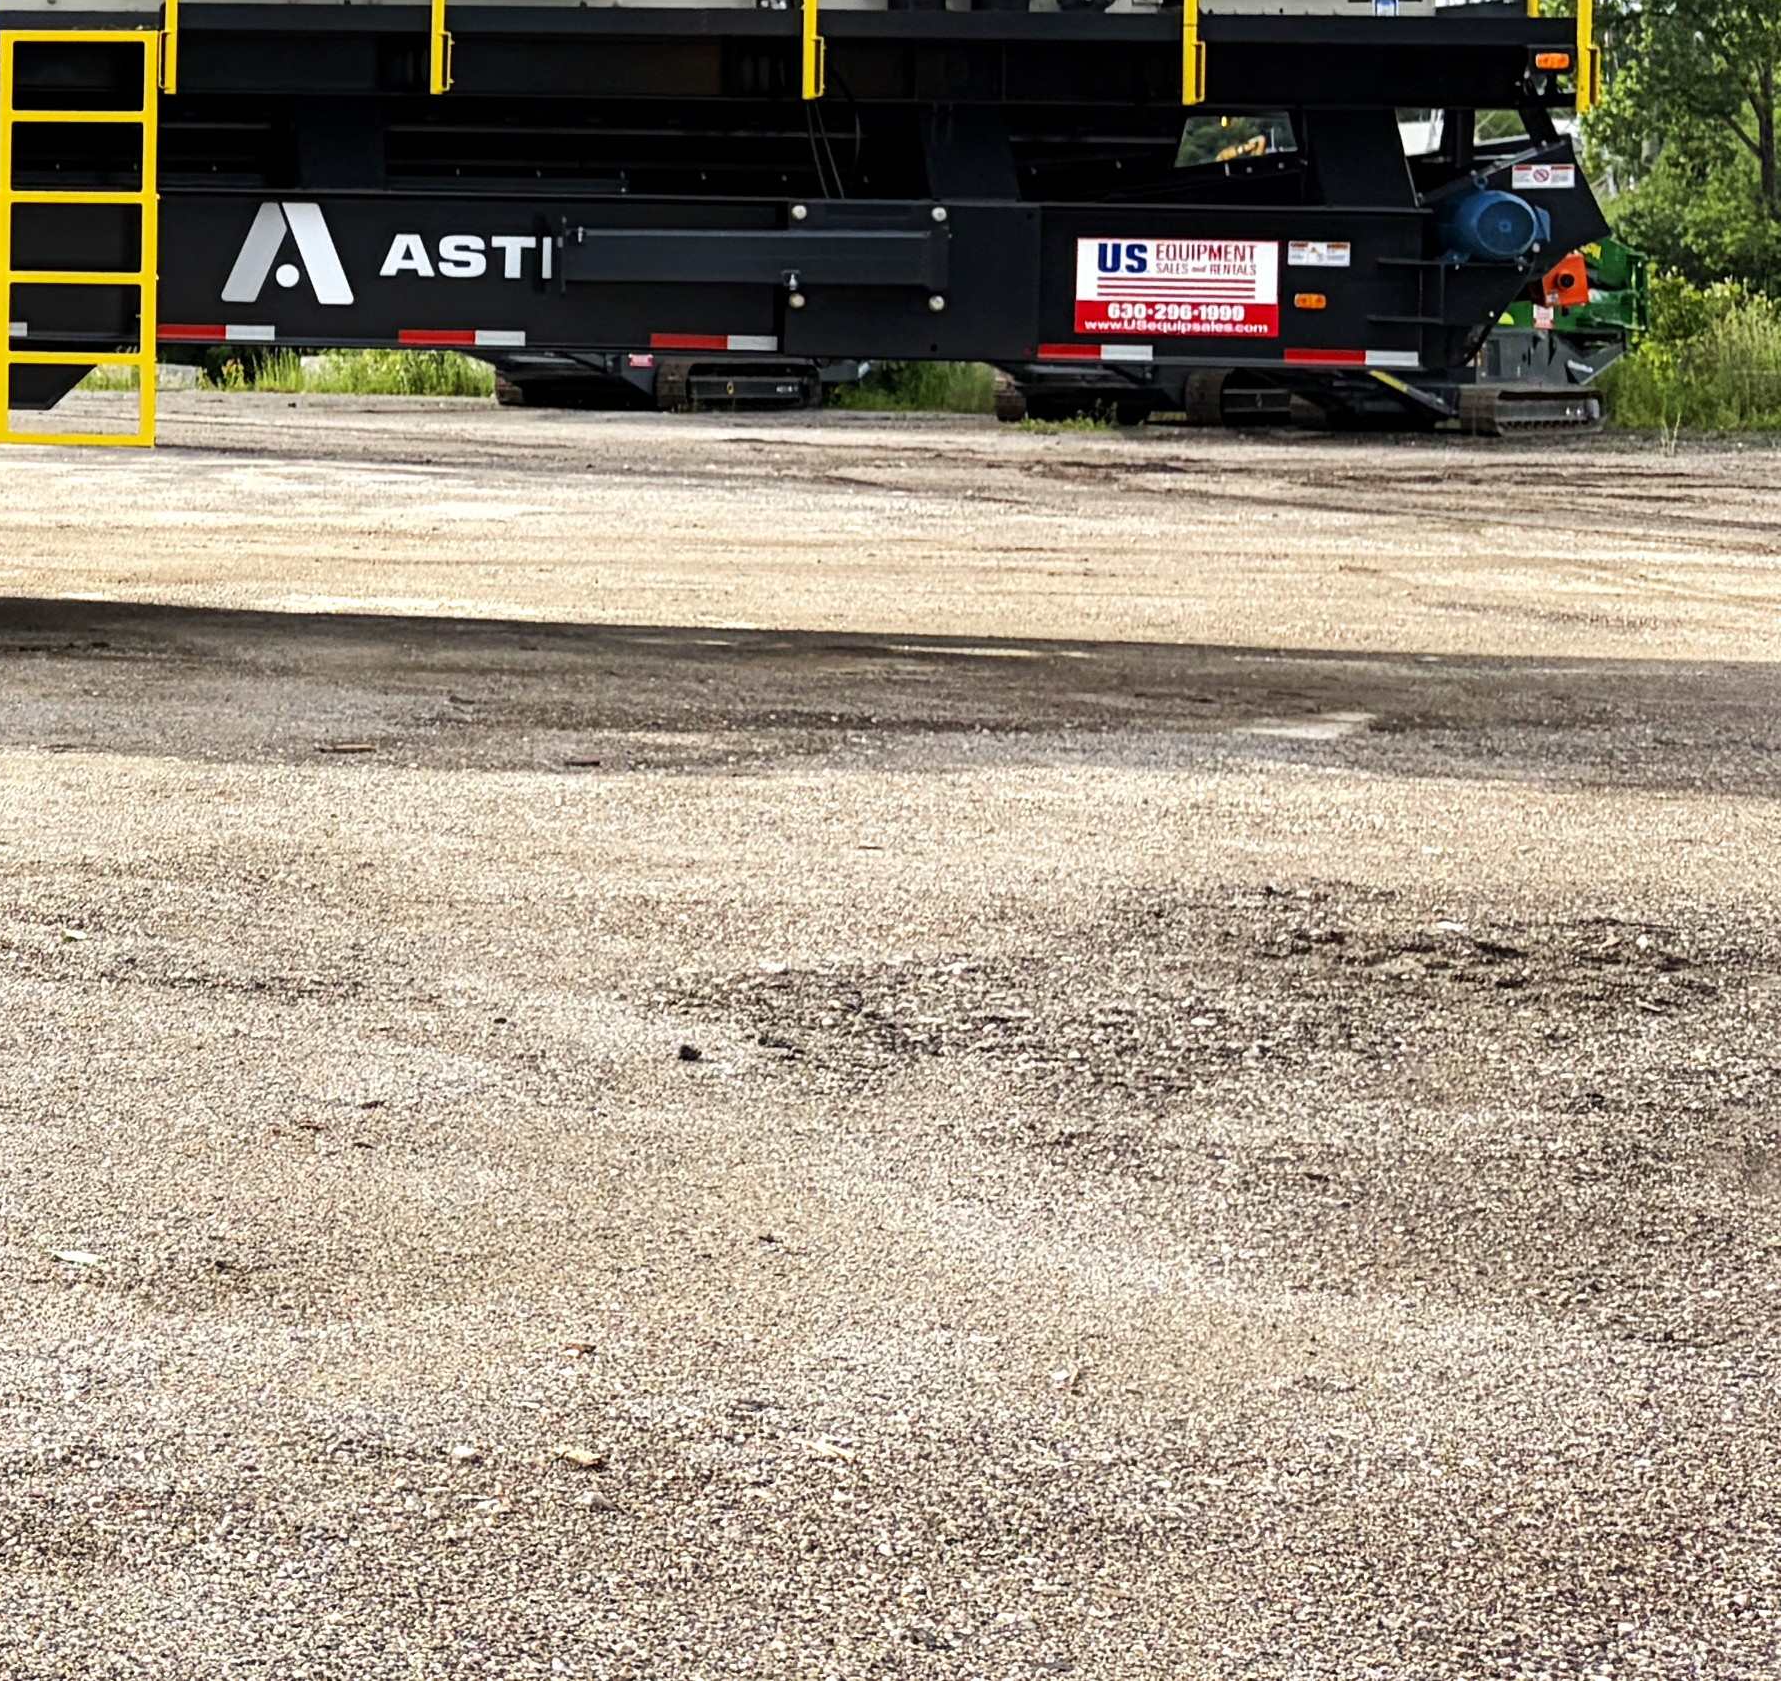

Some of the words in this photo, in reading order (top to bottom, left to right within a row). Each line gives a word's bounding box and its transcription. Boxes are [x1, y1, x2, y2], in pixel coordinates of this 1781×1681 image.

[1098, 243, 1147, 273] US
[1156, 243, 1257, 262] EQUIPMENT
[1156, 263, 1188, 275] SALES
[1210, 263, 1257, 276] RENTALS
[1084, 320, 1269, 334] www.USequipsales.com
